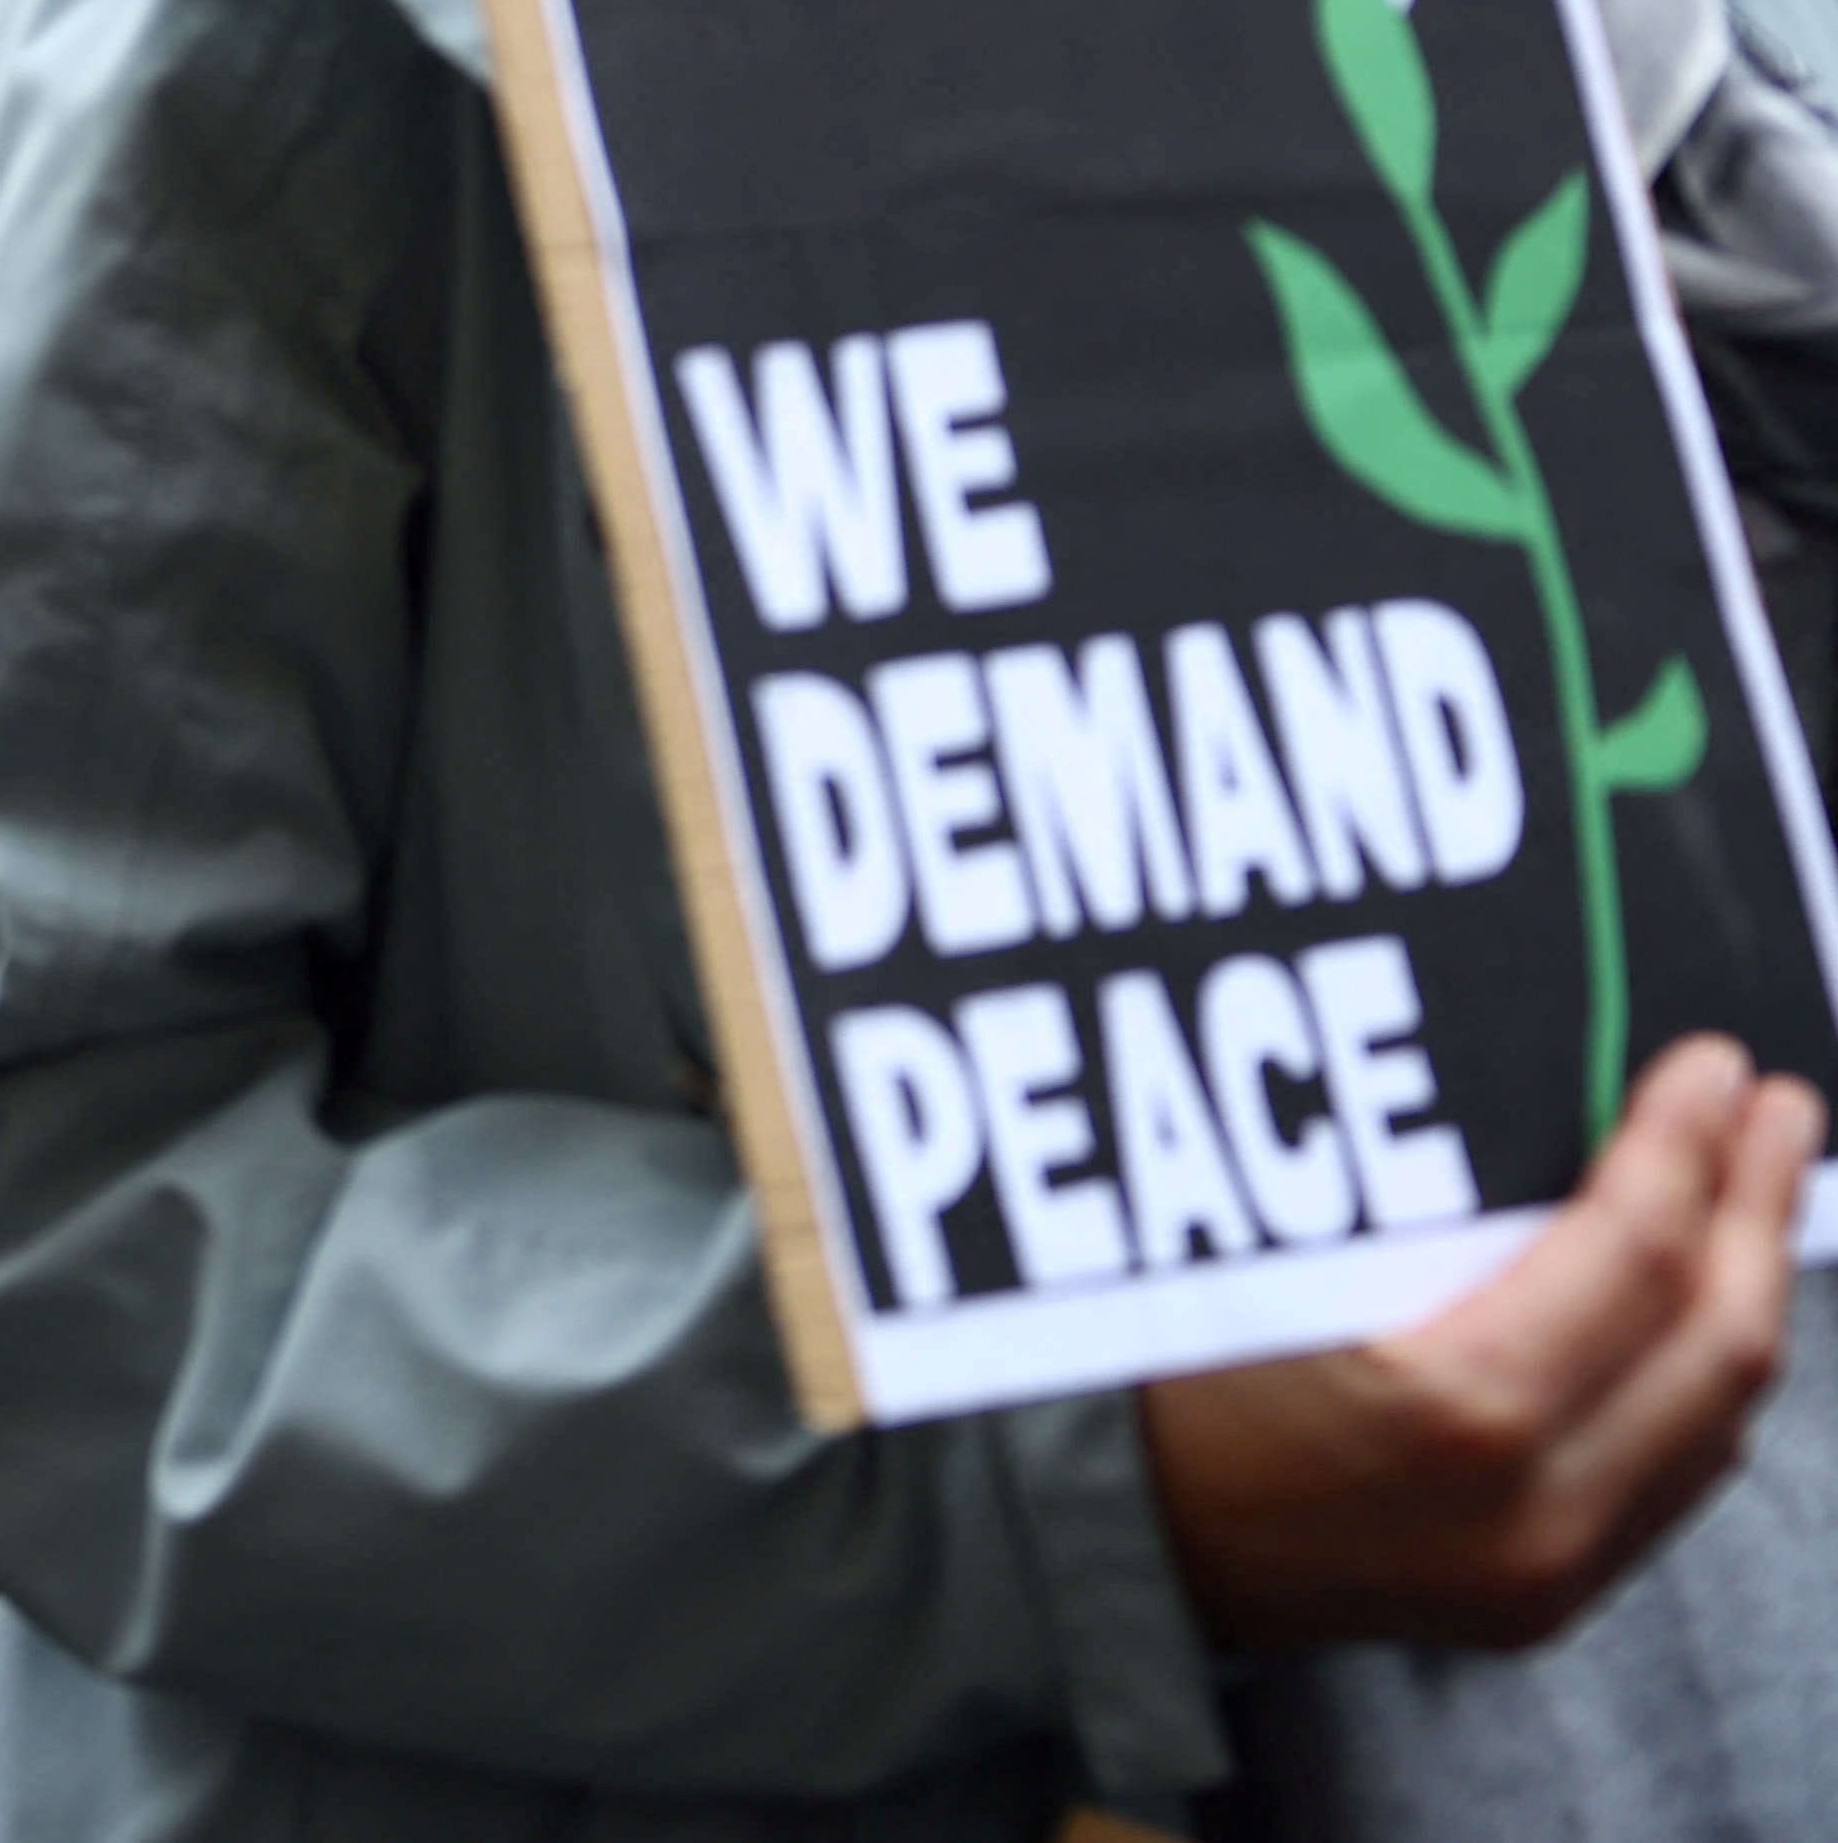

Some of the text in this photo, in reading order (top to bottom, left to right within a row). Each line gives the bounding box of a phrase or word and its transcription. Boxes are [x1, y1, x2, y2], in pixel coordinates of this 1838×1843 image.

[674, 318, 1053, 633] WE
[750, 596, 1525, 974] DEMAND
[831, 933, 1481, 1312] PEACE
